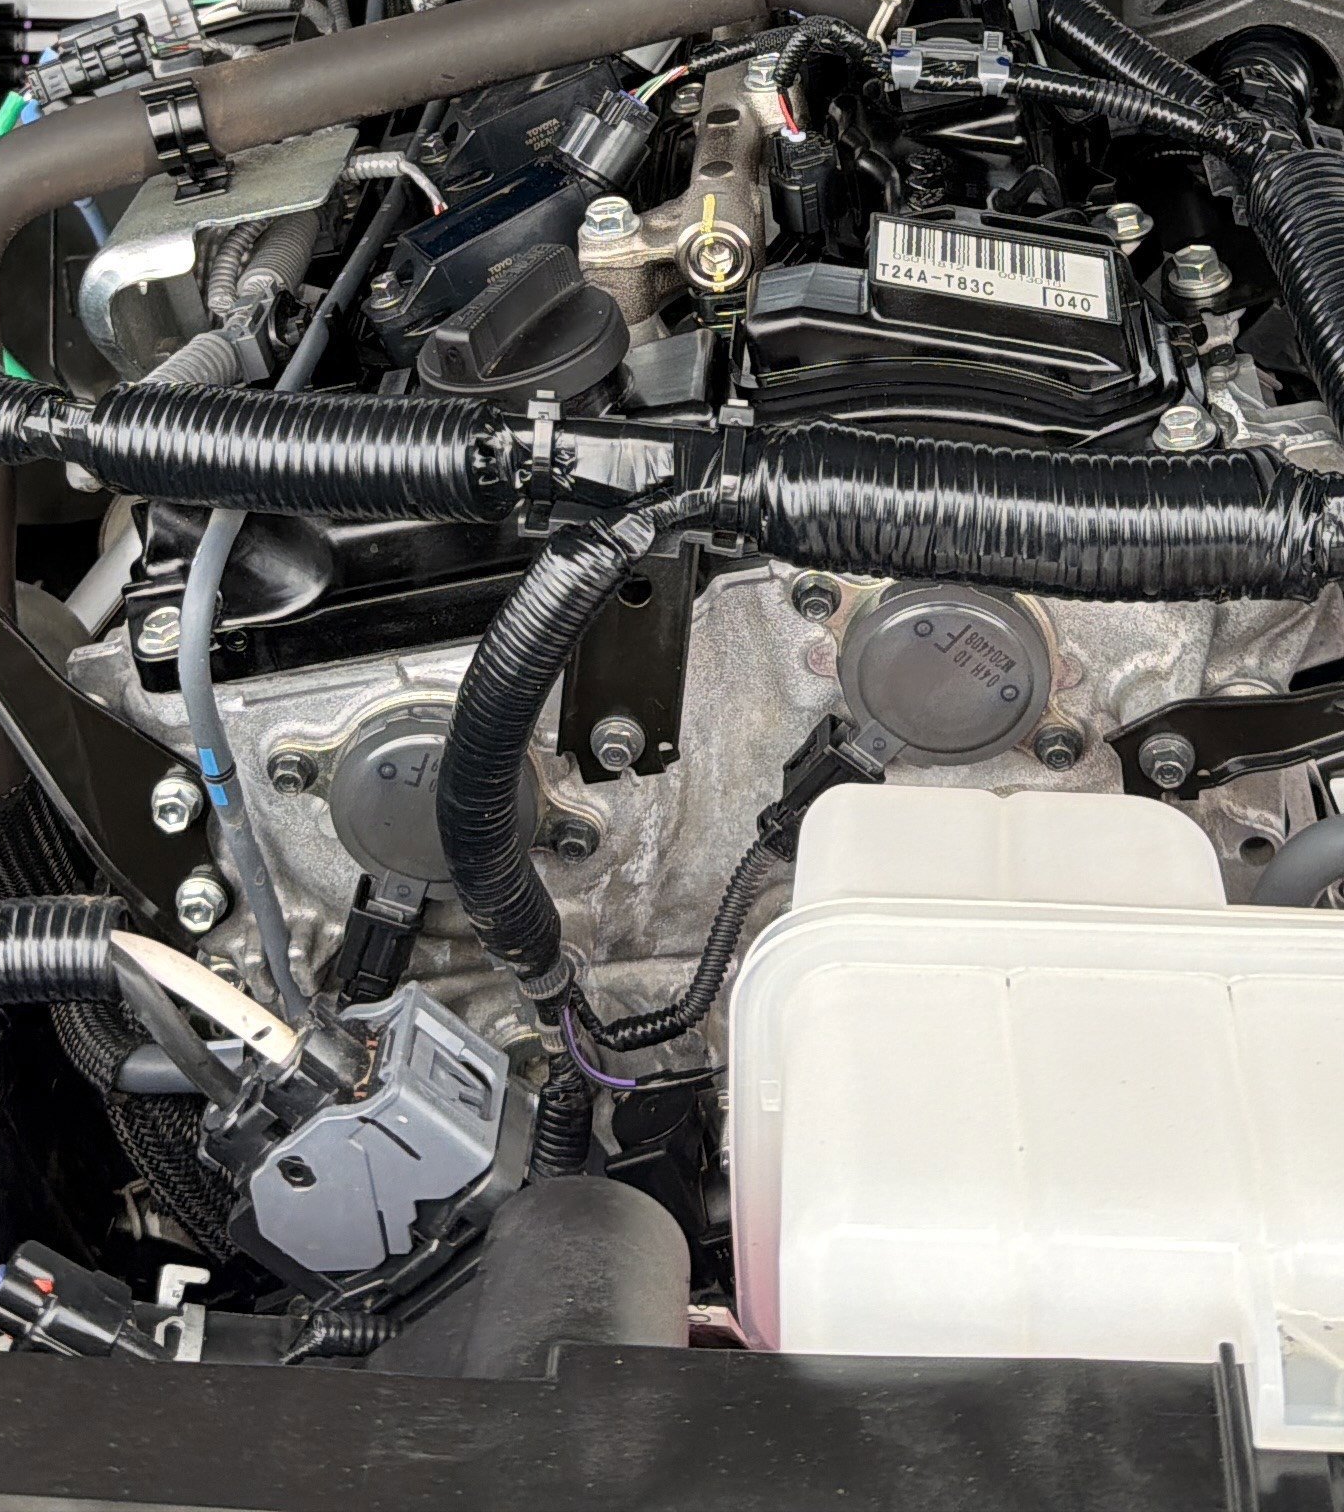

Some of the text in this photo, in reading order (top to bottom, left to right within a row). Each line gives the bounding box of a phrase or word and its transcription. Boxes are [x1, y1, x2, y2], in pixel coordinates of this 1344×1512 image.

[526, 118, 561, 137] TOYOTA
[879, 262, 995, 296] T24A-T83C
[1054, 293, 1092, 313] 040
[933, 624, 973, 654] F
[404, 752, 431, 788] F
